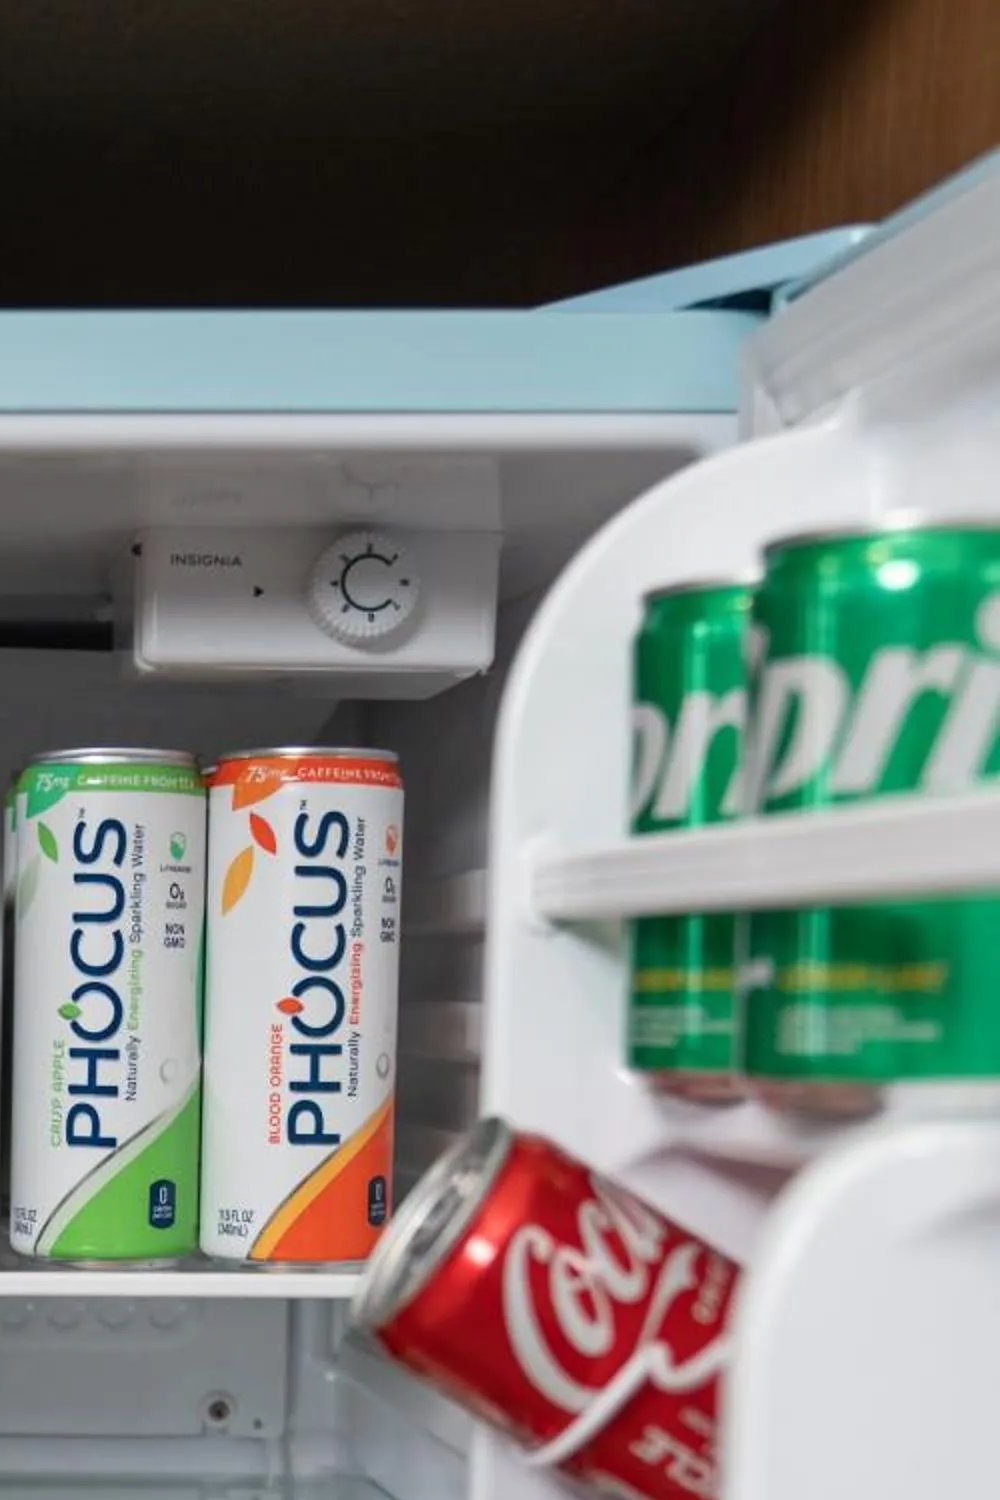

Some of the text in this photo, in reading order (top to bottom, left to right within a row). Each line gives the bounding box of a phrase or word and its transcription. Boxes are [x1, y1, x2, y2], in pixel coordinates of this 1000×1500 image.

[170, 553, 243, 568] INSIGNIA
[746, 588, 1000, 816] pri
[131, 823, 148, 869] Water
[129, 871, 147, 944] Sparkling
[347, 816, 367, 1097] Naturally Energizing Sparkling Water
[124, 1035, 142, 1102] Naturally
[268, 1023, 284, 1145] BLOOD ORANGE
